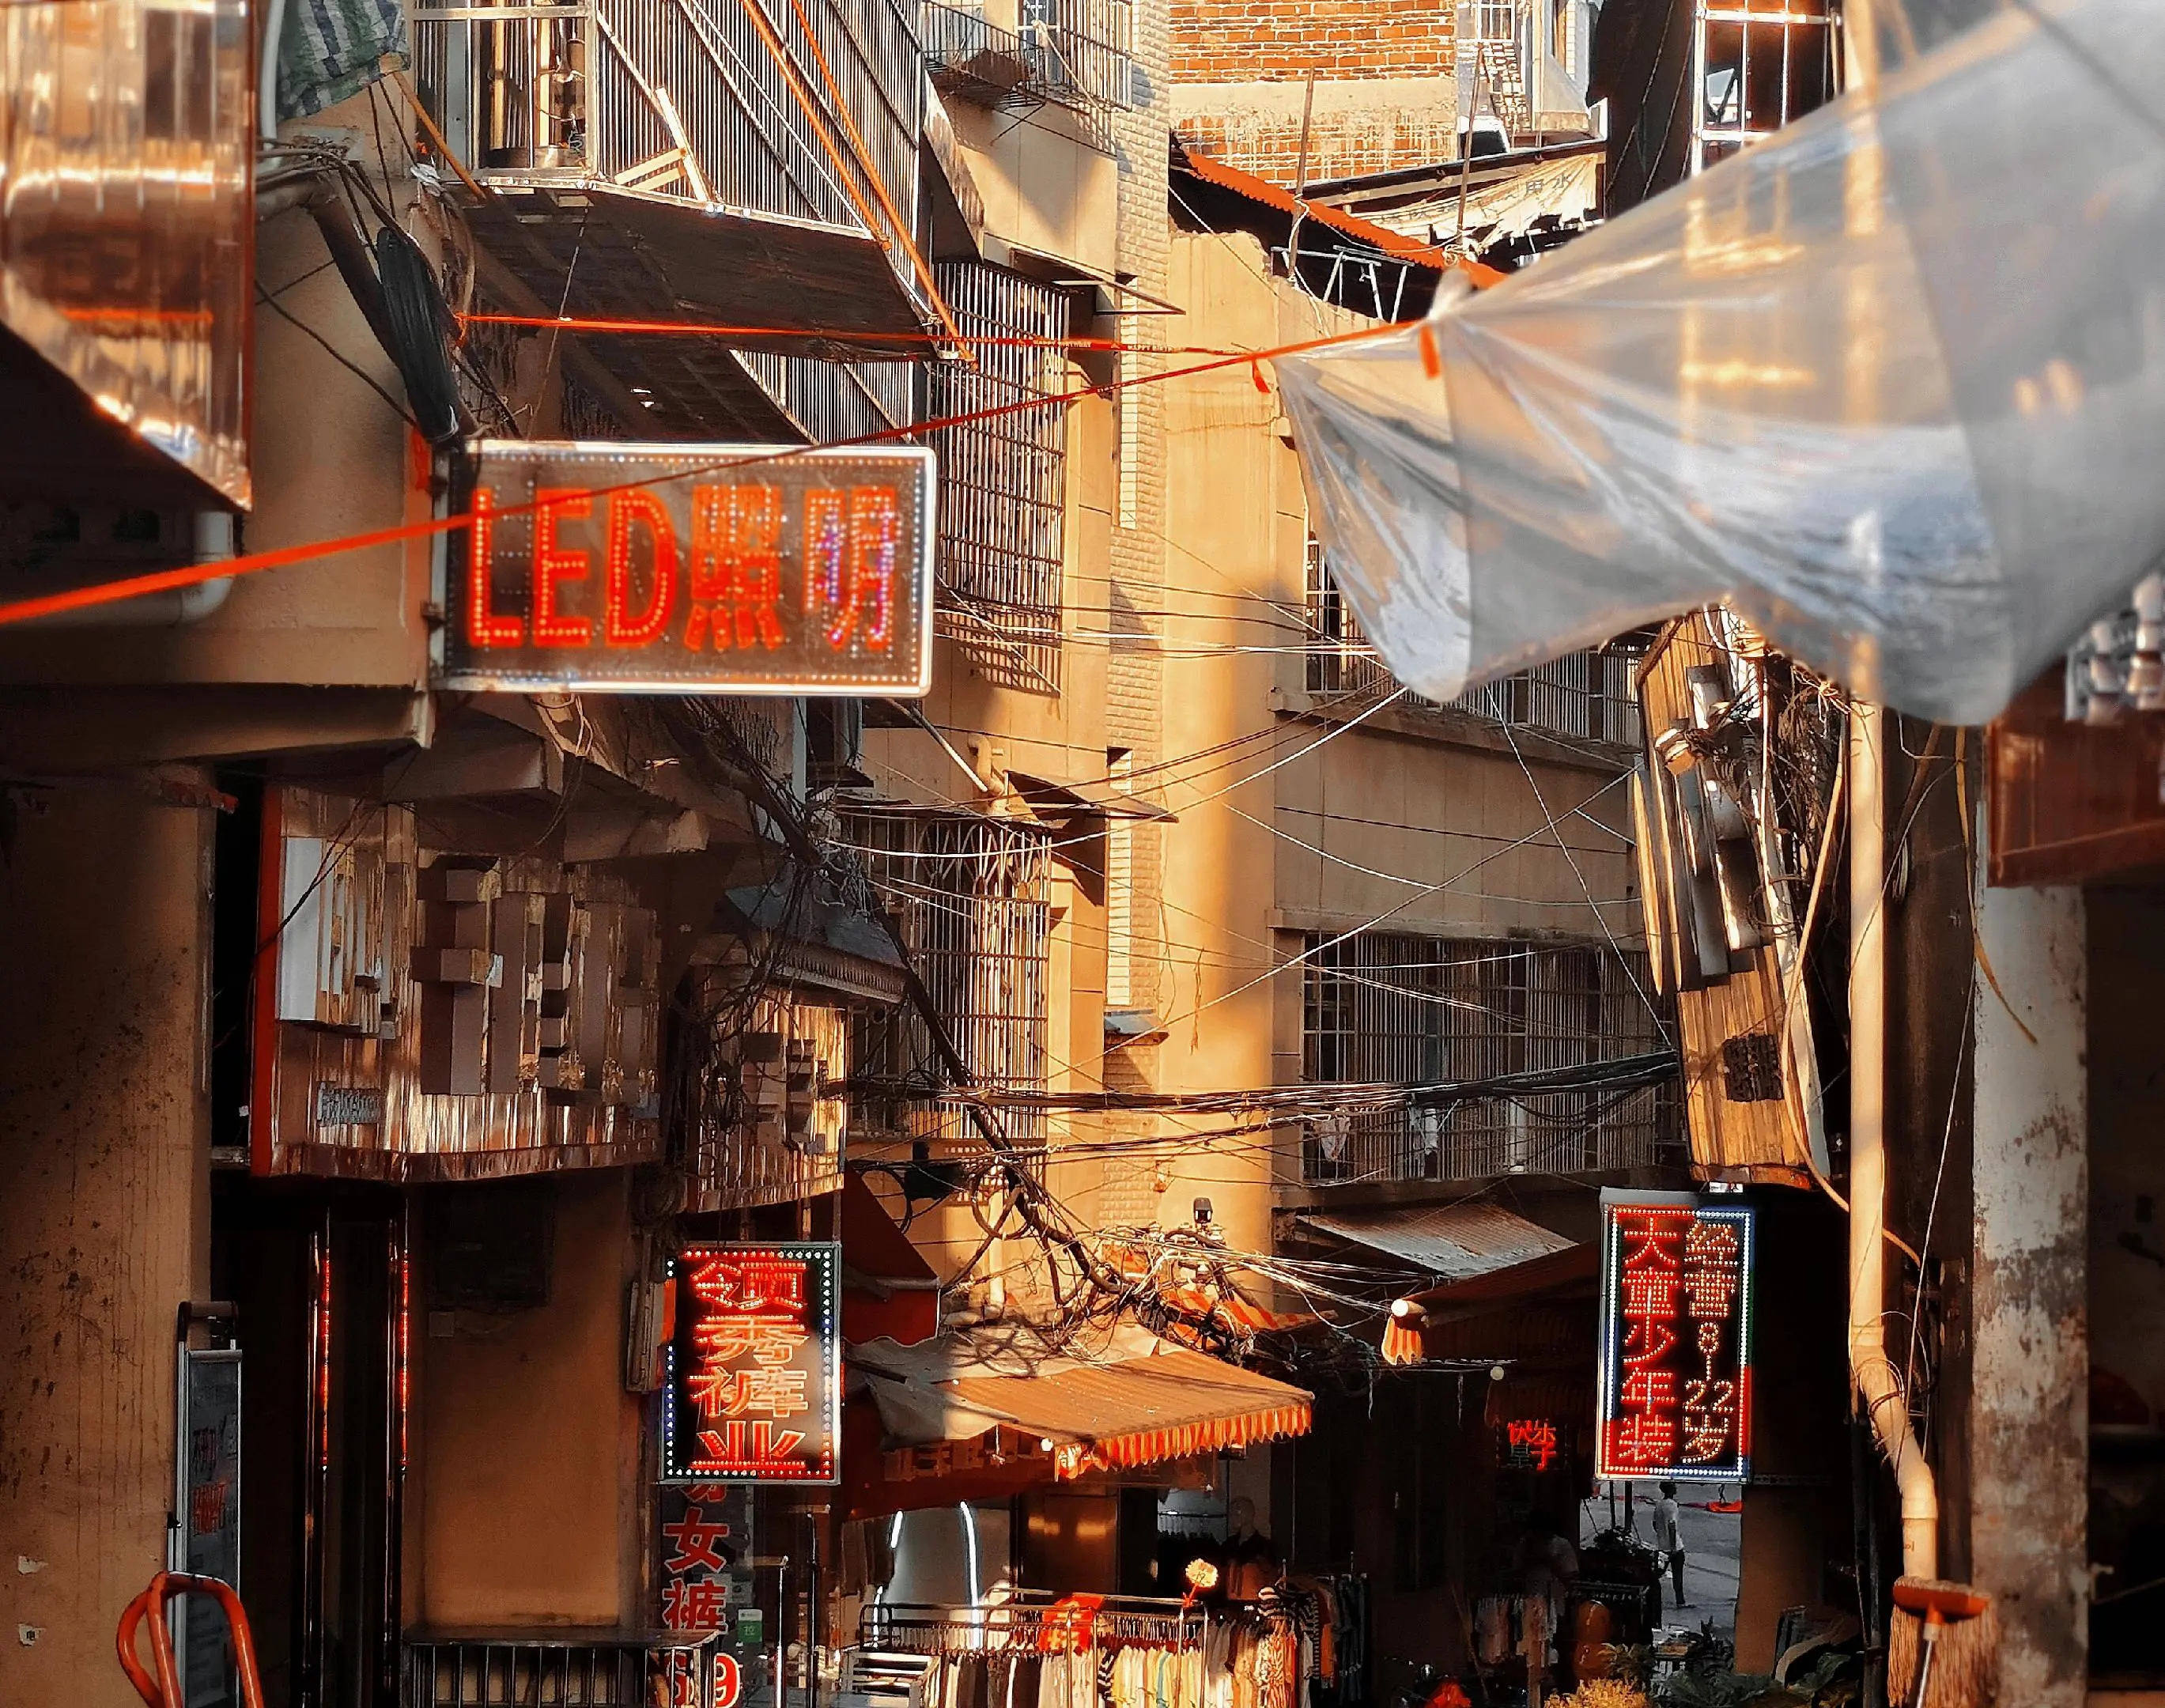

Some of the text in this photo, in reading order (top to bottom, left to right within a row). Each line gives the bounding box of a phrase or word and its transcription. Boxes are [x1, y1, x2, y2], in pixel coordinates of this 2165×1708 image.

[468, 484, 897, 653] LED照明
[686, 1259, 810, 1468] 领秀裤业
[1619, 1218, 1679, 1464] 大童少年装
